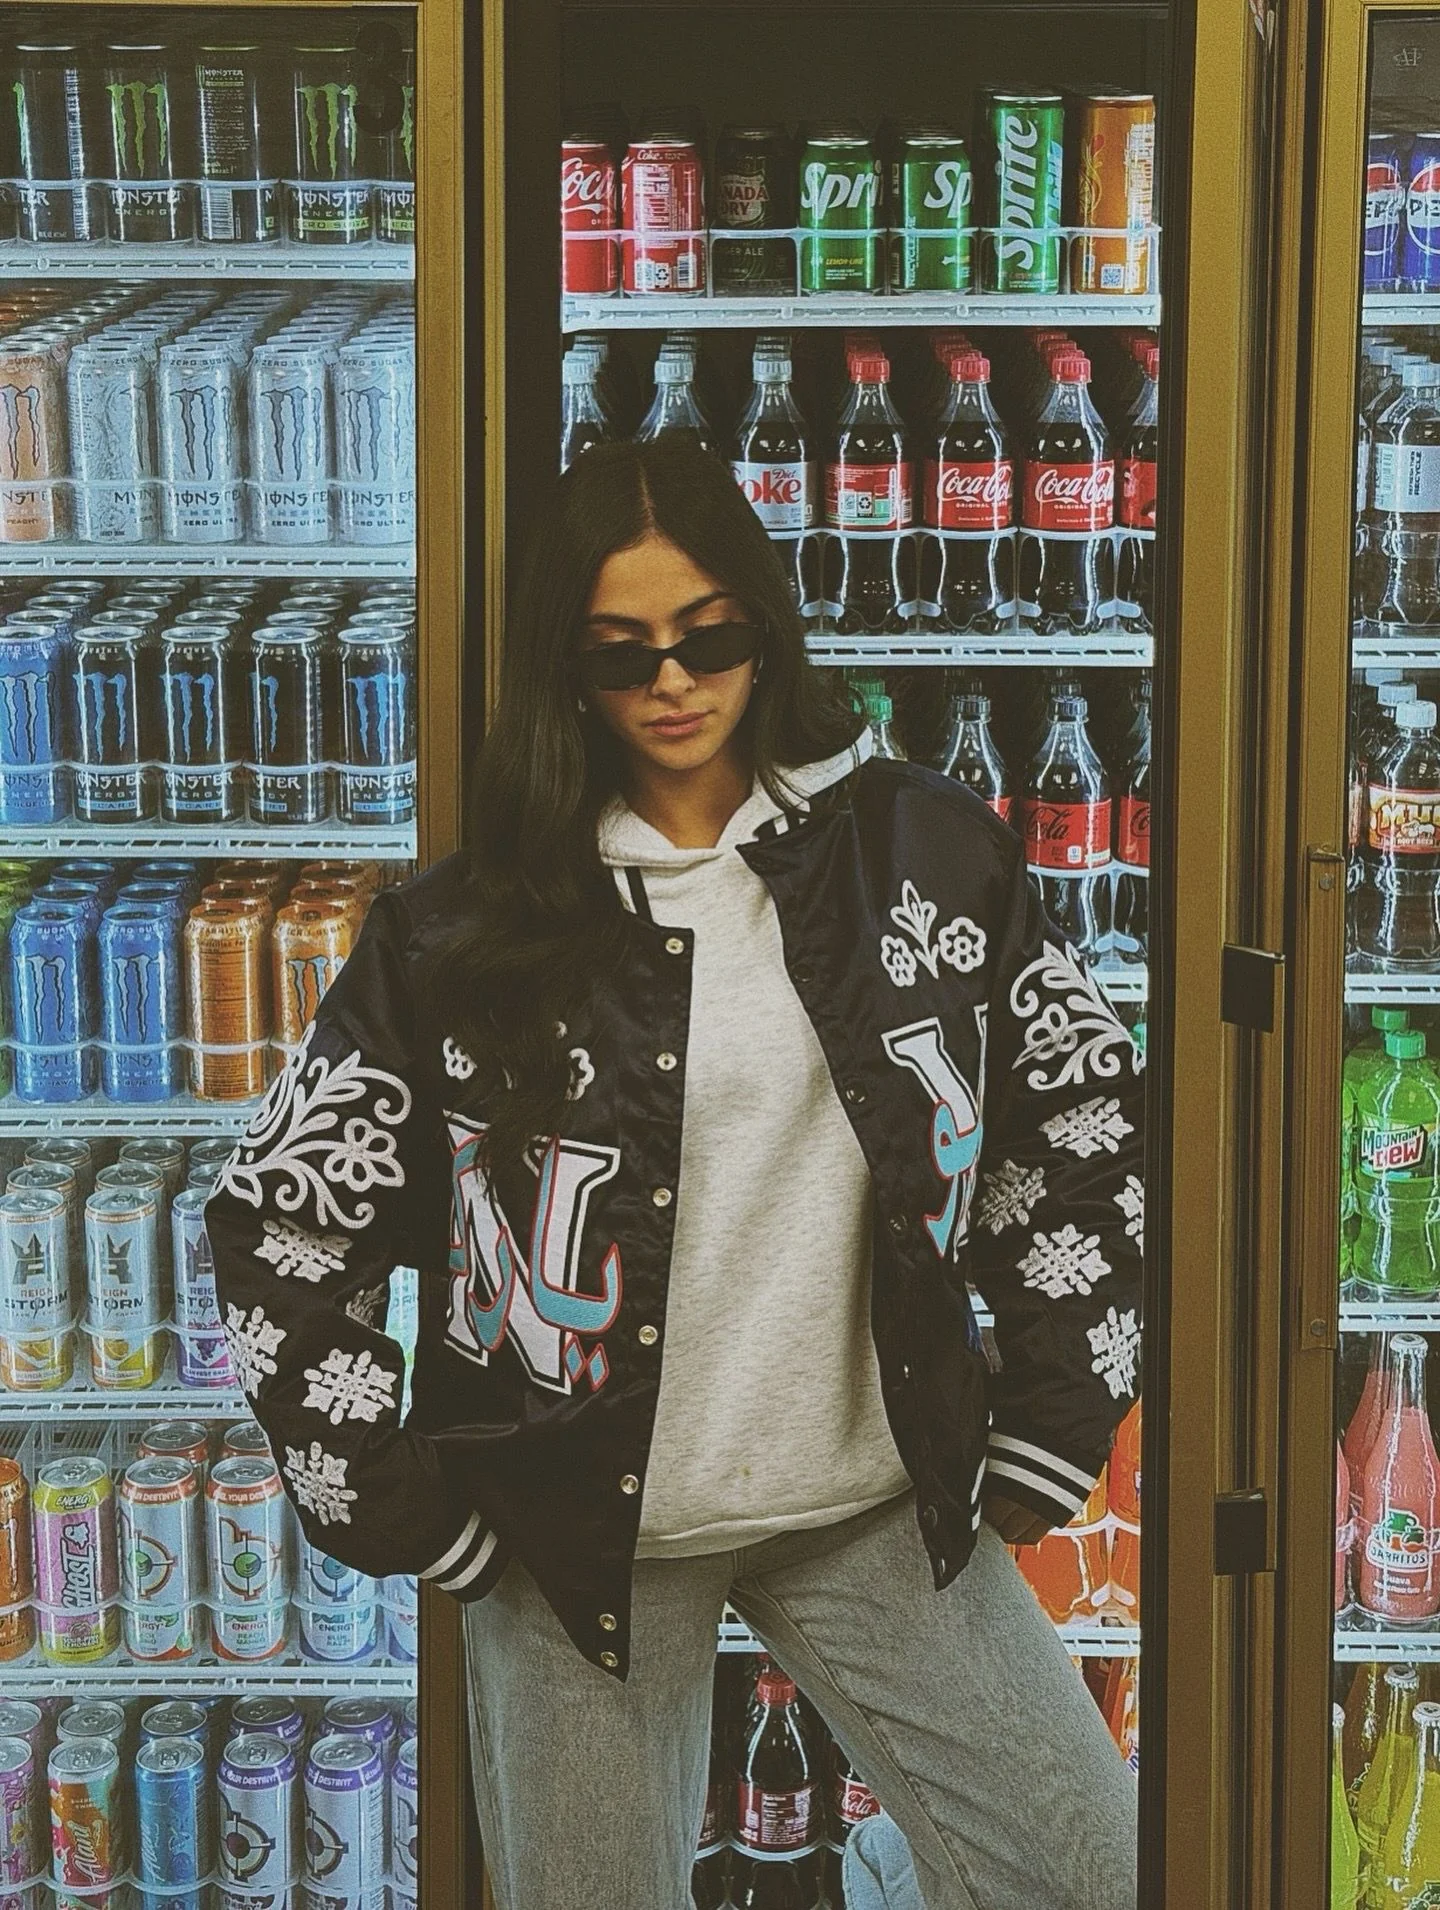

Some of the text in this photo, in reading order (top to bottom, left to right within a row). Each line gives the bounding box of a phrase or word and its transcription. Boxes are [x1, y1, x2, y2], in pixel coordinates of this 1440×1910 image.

[744, 247, 765, 256] ALE
[1414, 451, 1422, 496] RECYCLE
[168, 490, 241, 507] MONSTE
[4, 1290, 68, 1313] STORM
[1370, 1546, 1426, 1565] JARRITOS
[242, 1774, 278, 1785] DESTINY
[318, 1777, 353, 1786] DESTINY
